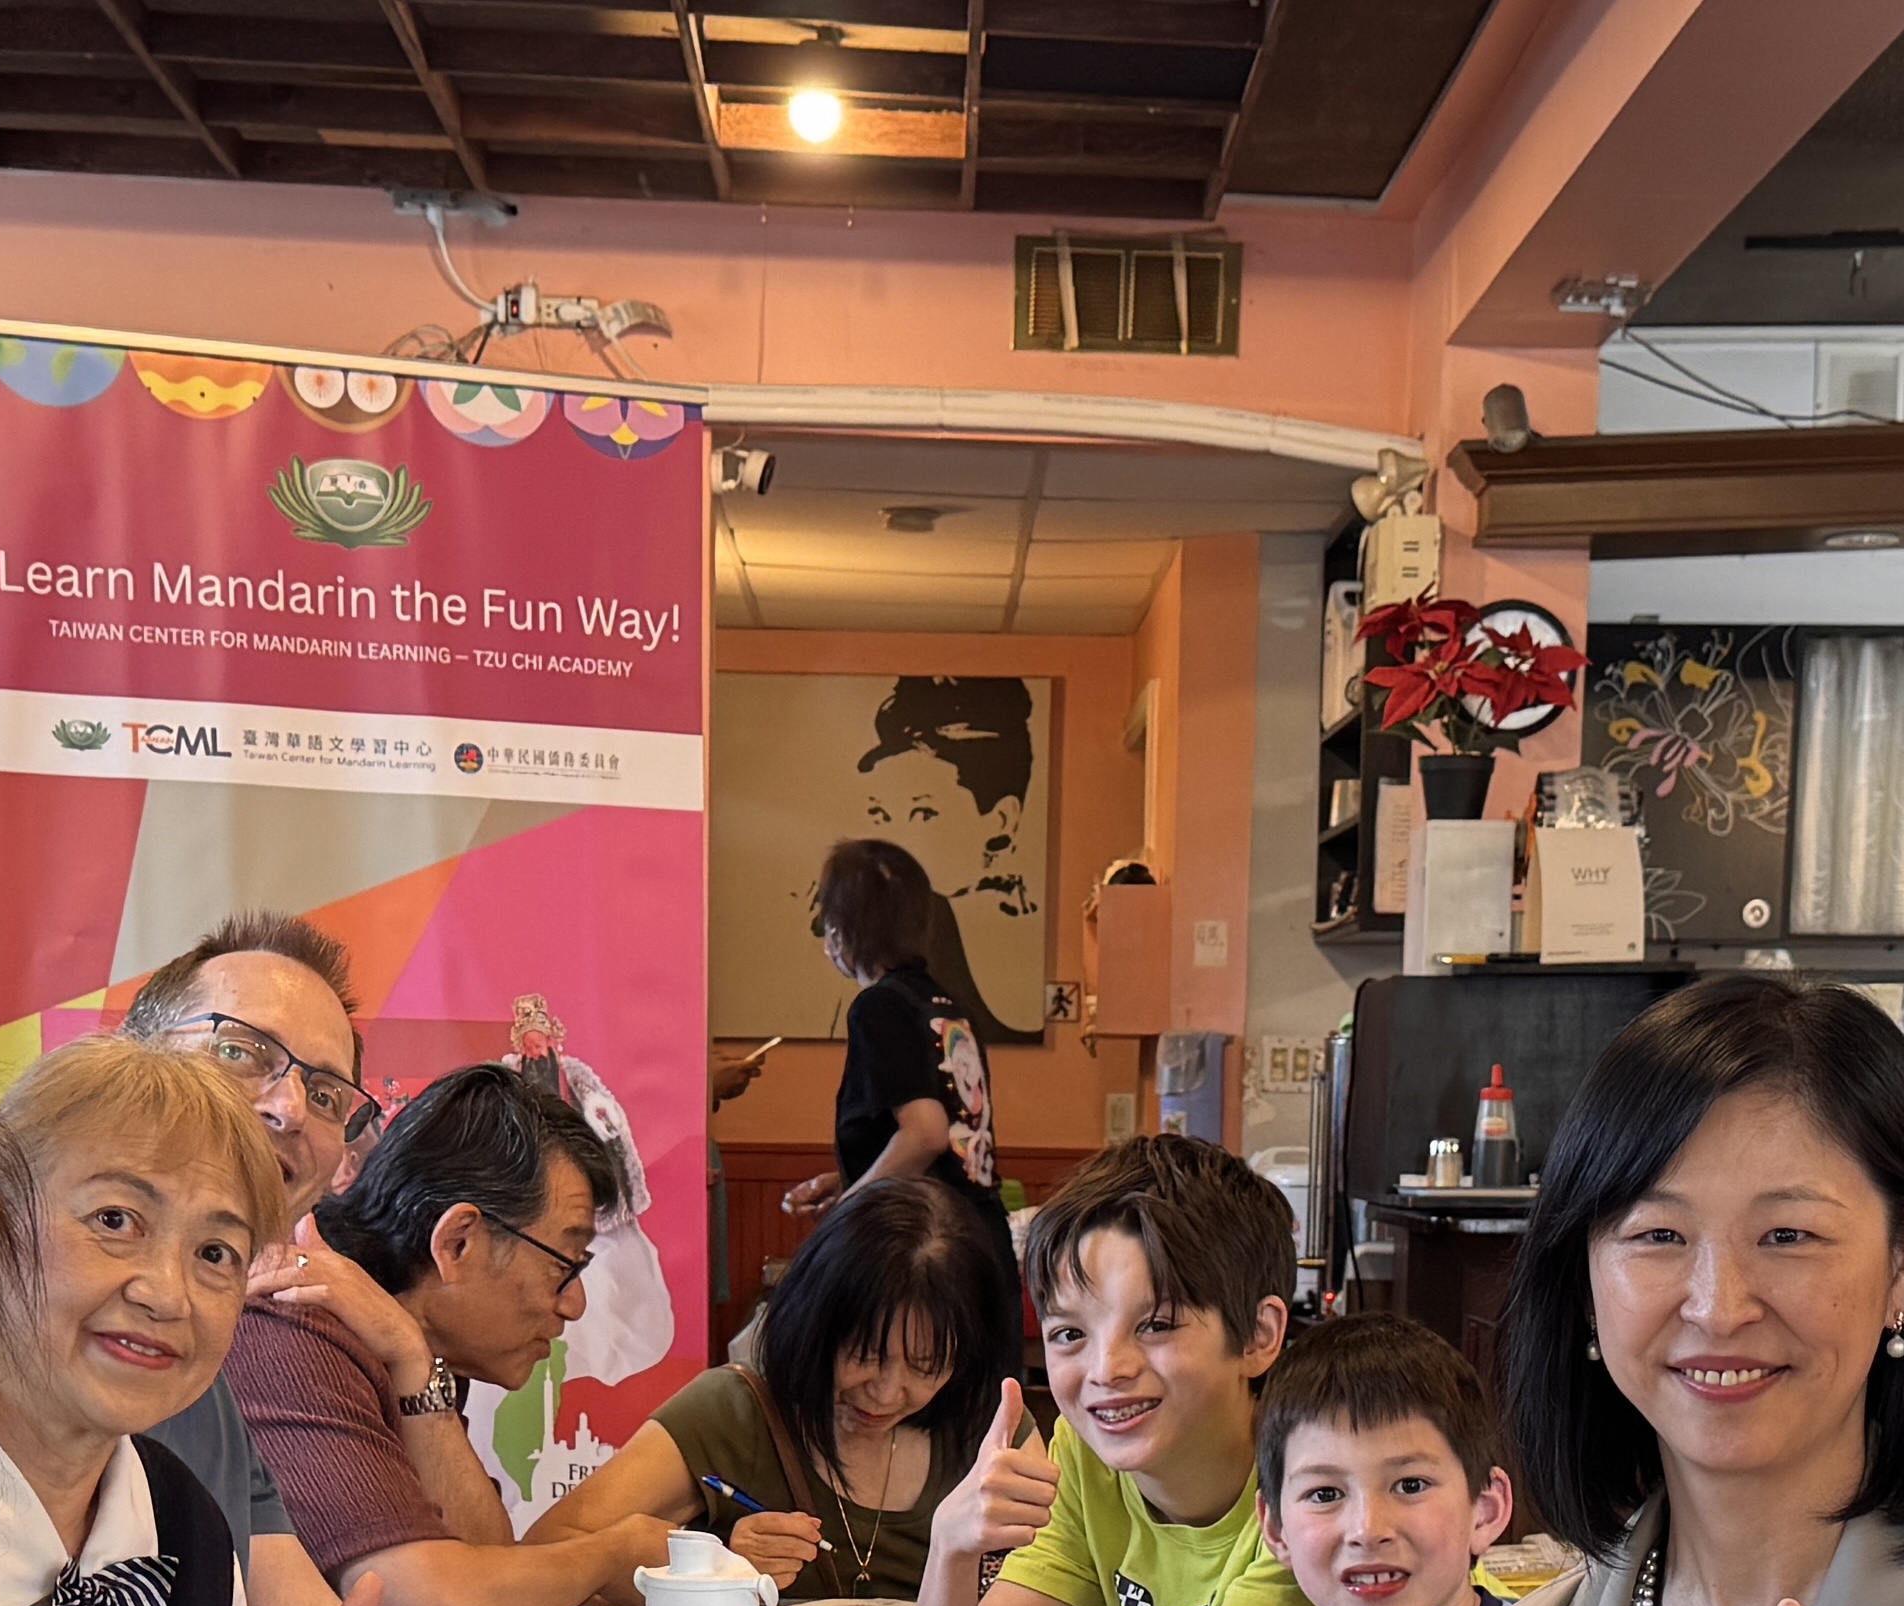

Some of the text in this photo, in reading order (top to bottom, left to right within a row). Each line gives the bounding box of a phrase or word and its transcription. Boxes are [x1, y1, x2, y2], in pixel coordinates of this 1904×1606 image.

[153, 562, 376, 619] Mandarin
[391, 580, 466, 625] the
[483, 588, 562, 633] Fun
[577, 595, 680, 651] Way!
[49, 619, 124, 641] TAIWAN
[129, 625, 205, 646] CENTER
[210, 630, 248, 649] FOR
[253, 634, 352, 658] MANDARIN
[357, 642, 451, 664] LEARNING
[473, 650, 507, 669] TZU
[512, 653, 543, 671] CHI
[547, 656, 633, 678] ACADEMY
[122, 722, 232, 758] TCML
[242, 729, 433, 757] 臺灣華語文學習中心
[243, 749, 436, 772] Taiwan Center for Mandarin Learning
[1571, 866, 1612, 880] WHY
